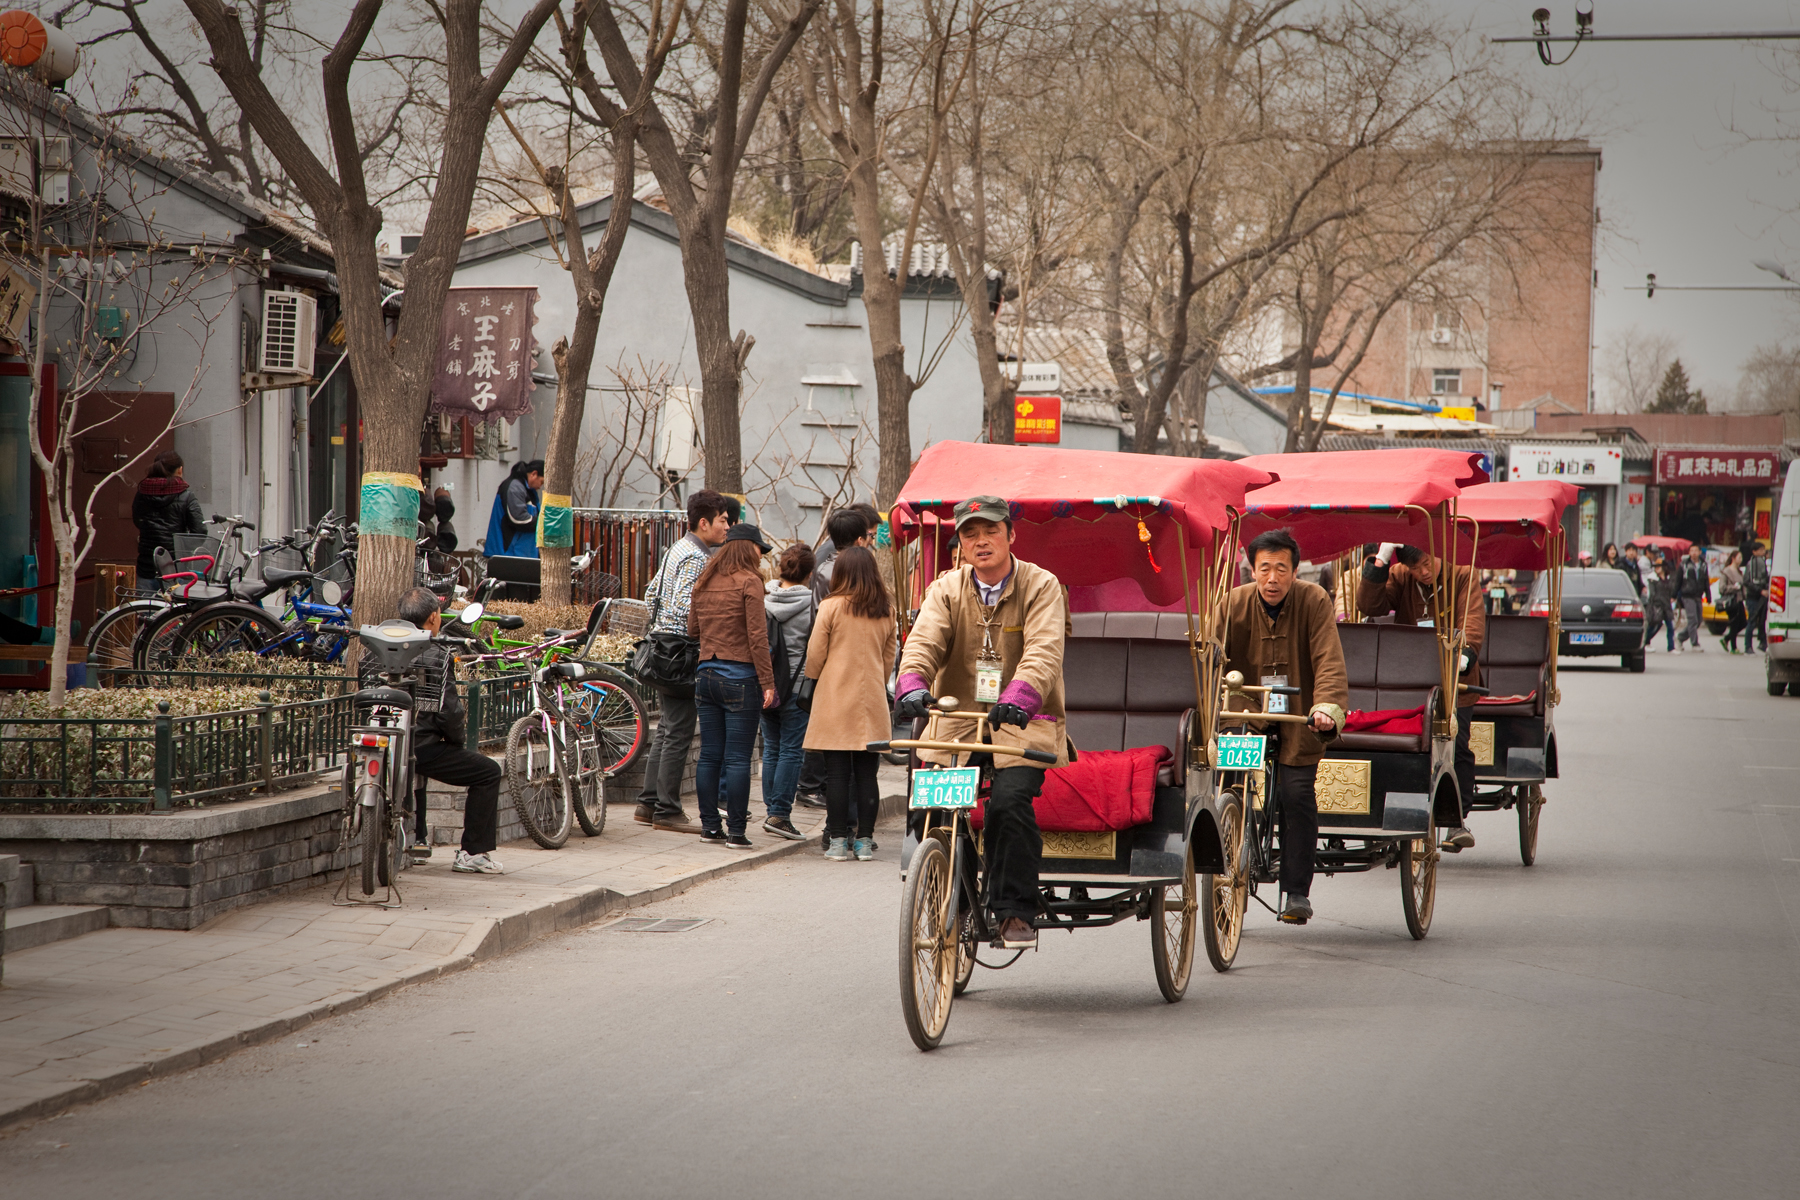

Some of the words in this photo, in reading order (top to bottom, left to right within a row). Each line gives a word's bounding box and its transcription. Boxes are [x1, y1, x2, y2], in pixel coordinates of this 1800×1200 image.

[466, 315, 501, 412] 王麻子
[1226, 750, 1260, 766] 0432
[918, 776, 934, 786] 西城
[916, 787, 930, 806] 客运
[933, 785, 974, 805] 0430
